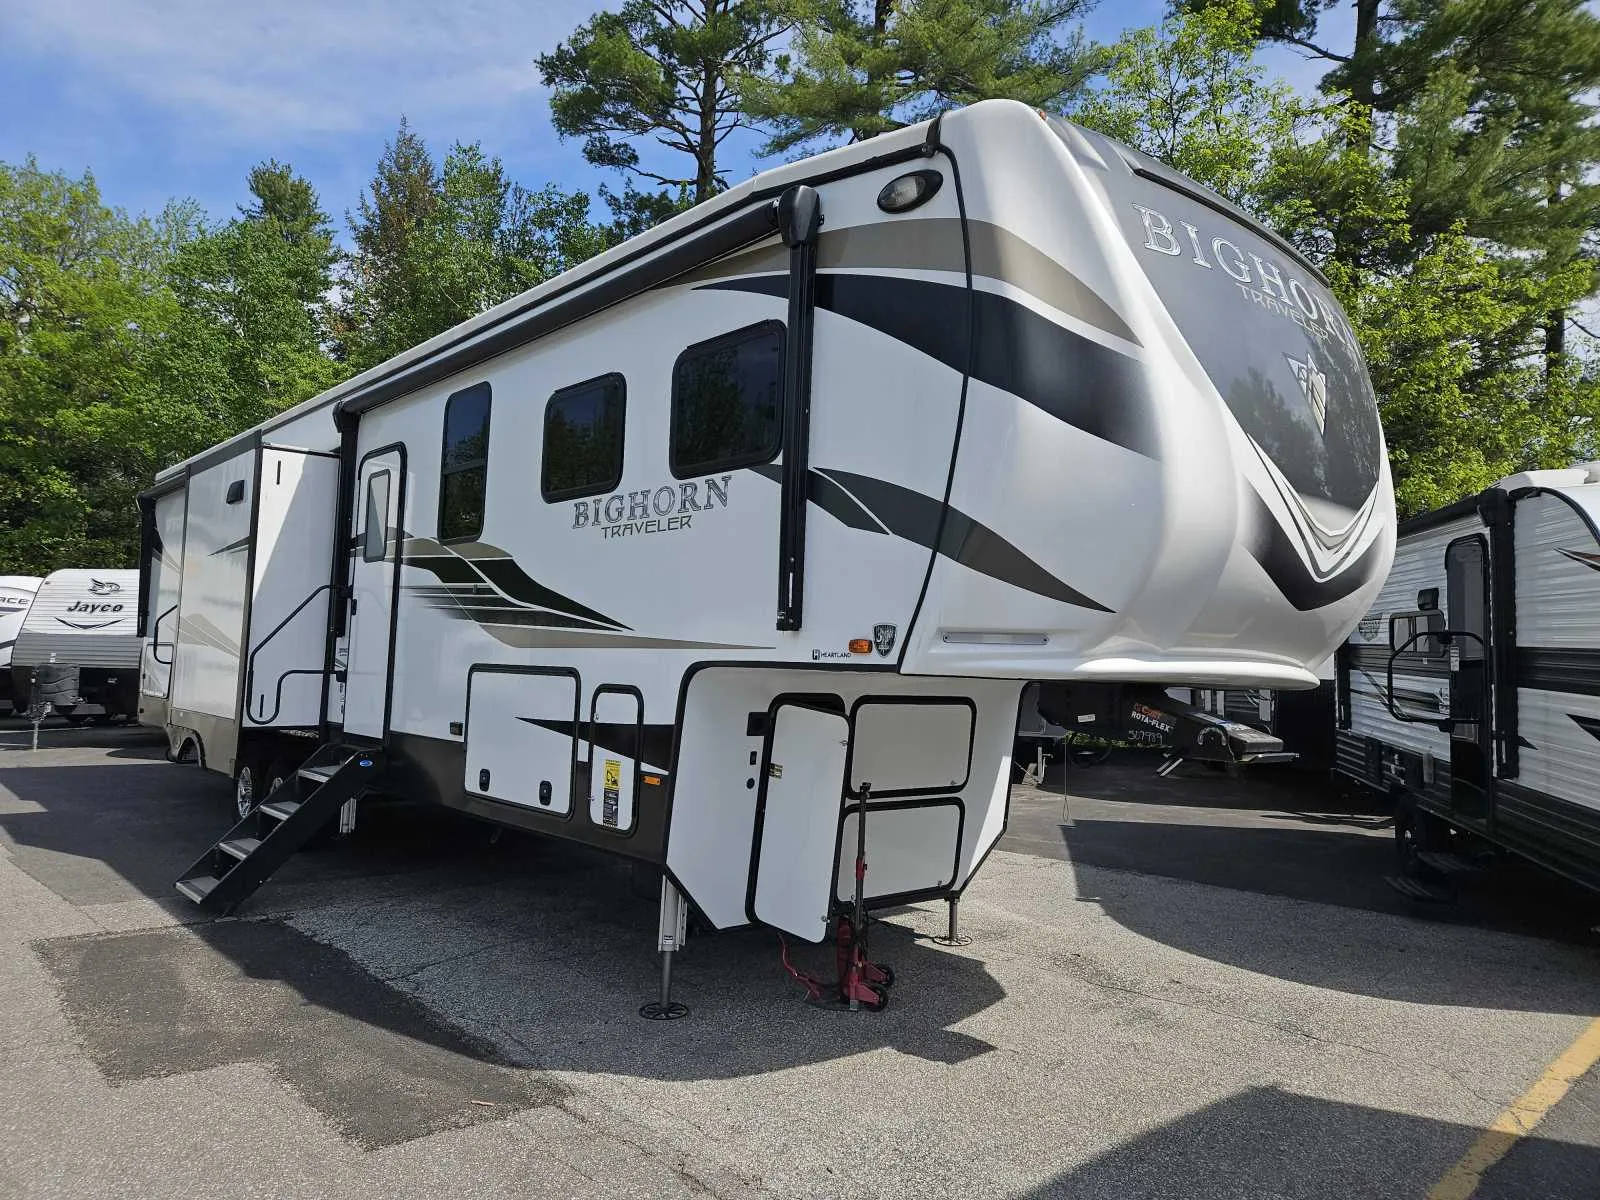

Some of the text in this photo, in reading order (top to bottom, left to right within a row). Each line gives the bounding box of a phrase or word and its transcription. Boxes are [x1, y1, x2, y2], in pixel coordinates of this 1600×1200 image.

[1235, 282, 1332, 344] TRAVELER
[572, 475, 731, 529] BIGHORN
[601, 514, 692, 540] TRAVELER
[67, 600, 124, 614] Jayco
[1131, 711, 1170, 733] ROTA-FLEX
